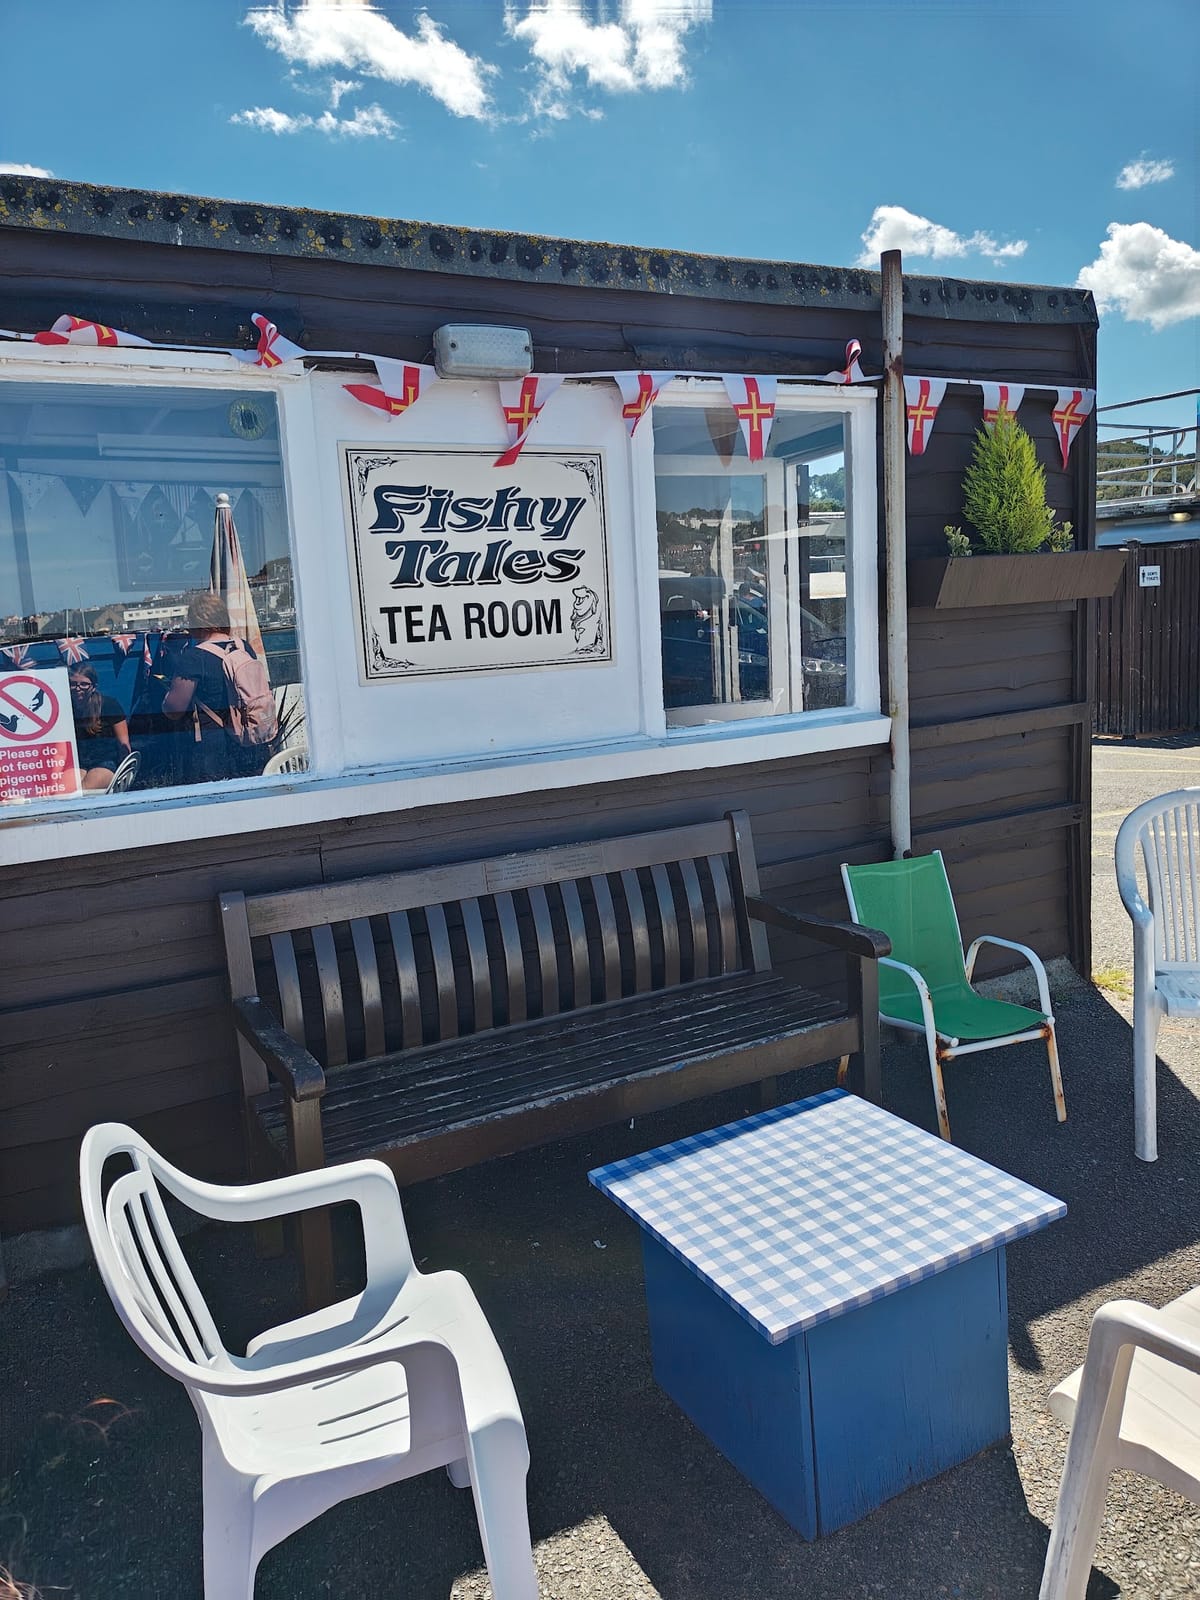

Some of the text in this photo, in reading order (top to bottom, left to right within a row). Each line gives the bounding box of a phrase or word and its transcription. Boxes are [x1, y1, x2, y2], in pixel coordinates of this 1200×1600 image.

[368, 484, 586, 540] Fishy
[385, 539, 585, 588] Tales
[380, 599, 562, 644] TEA ROOM
[0, 746, 57, 760] Please do
[0, 758, 65, 772] ot feed the
[0, 771, 64, 787] pigeons or
[0, 783, 65, 797] other birds
